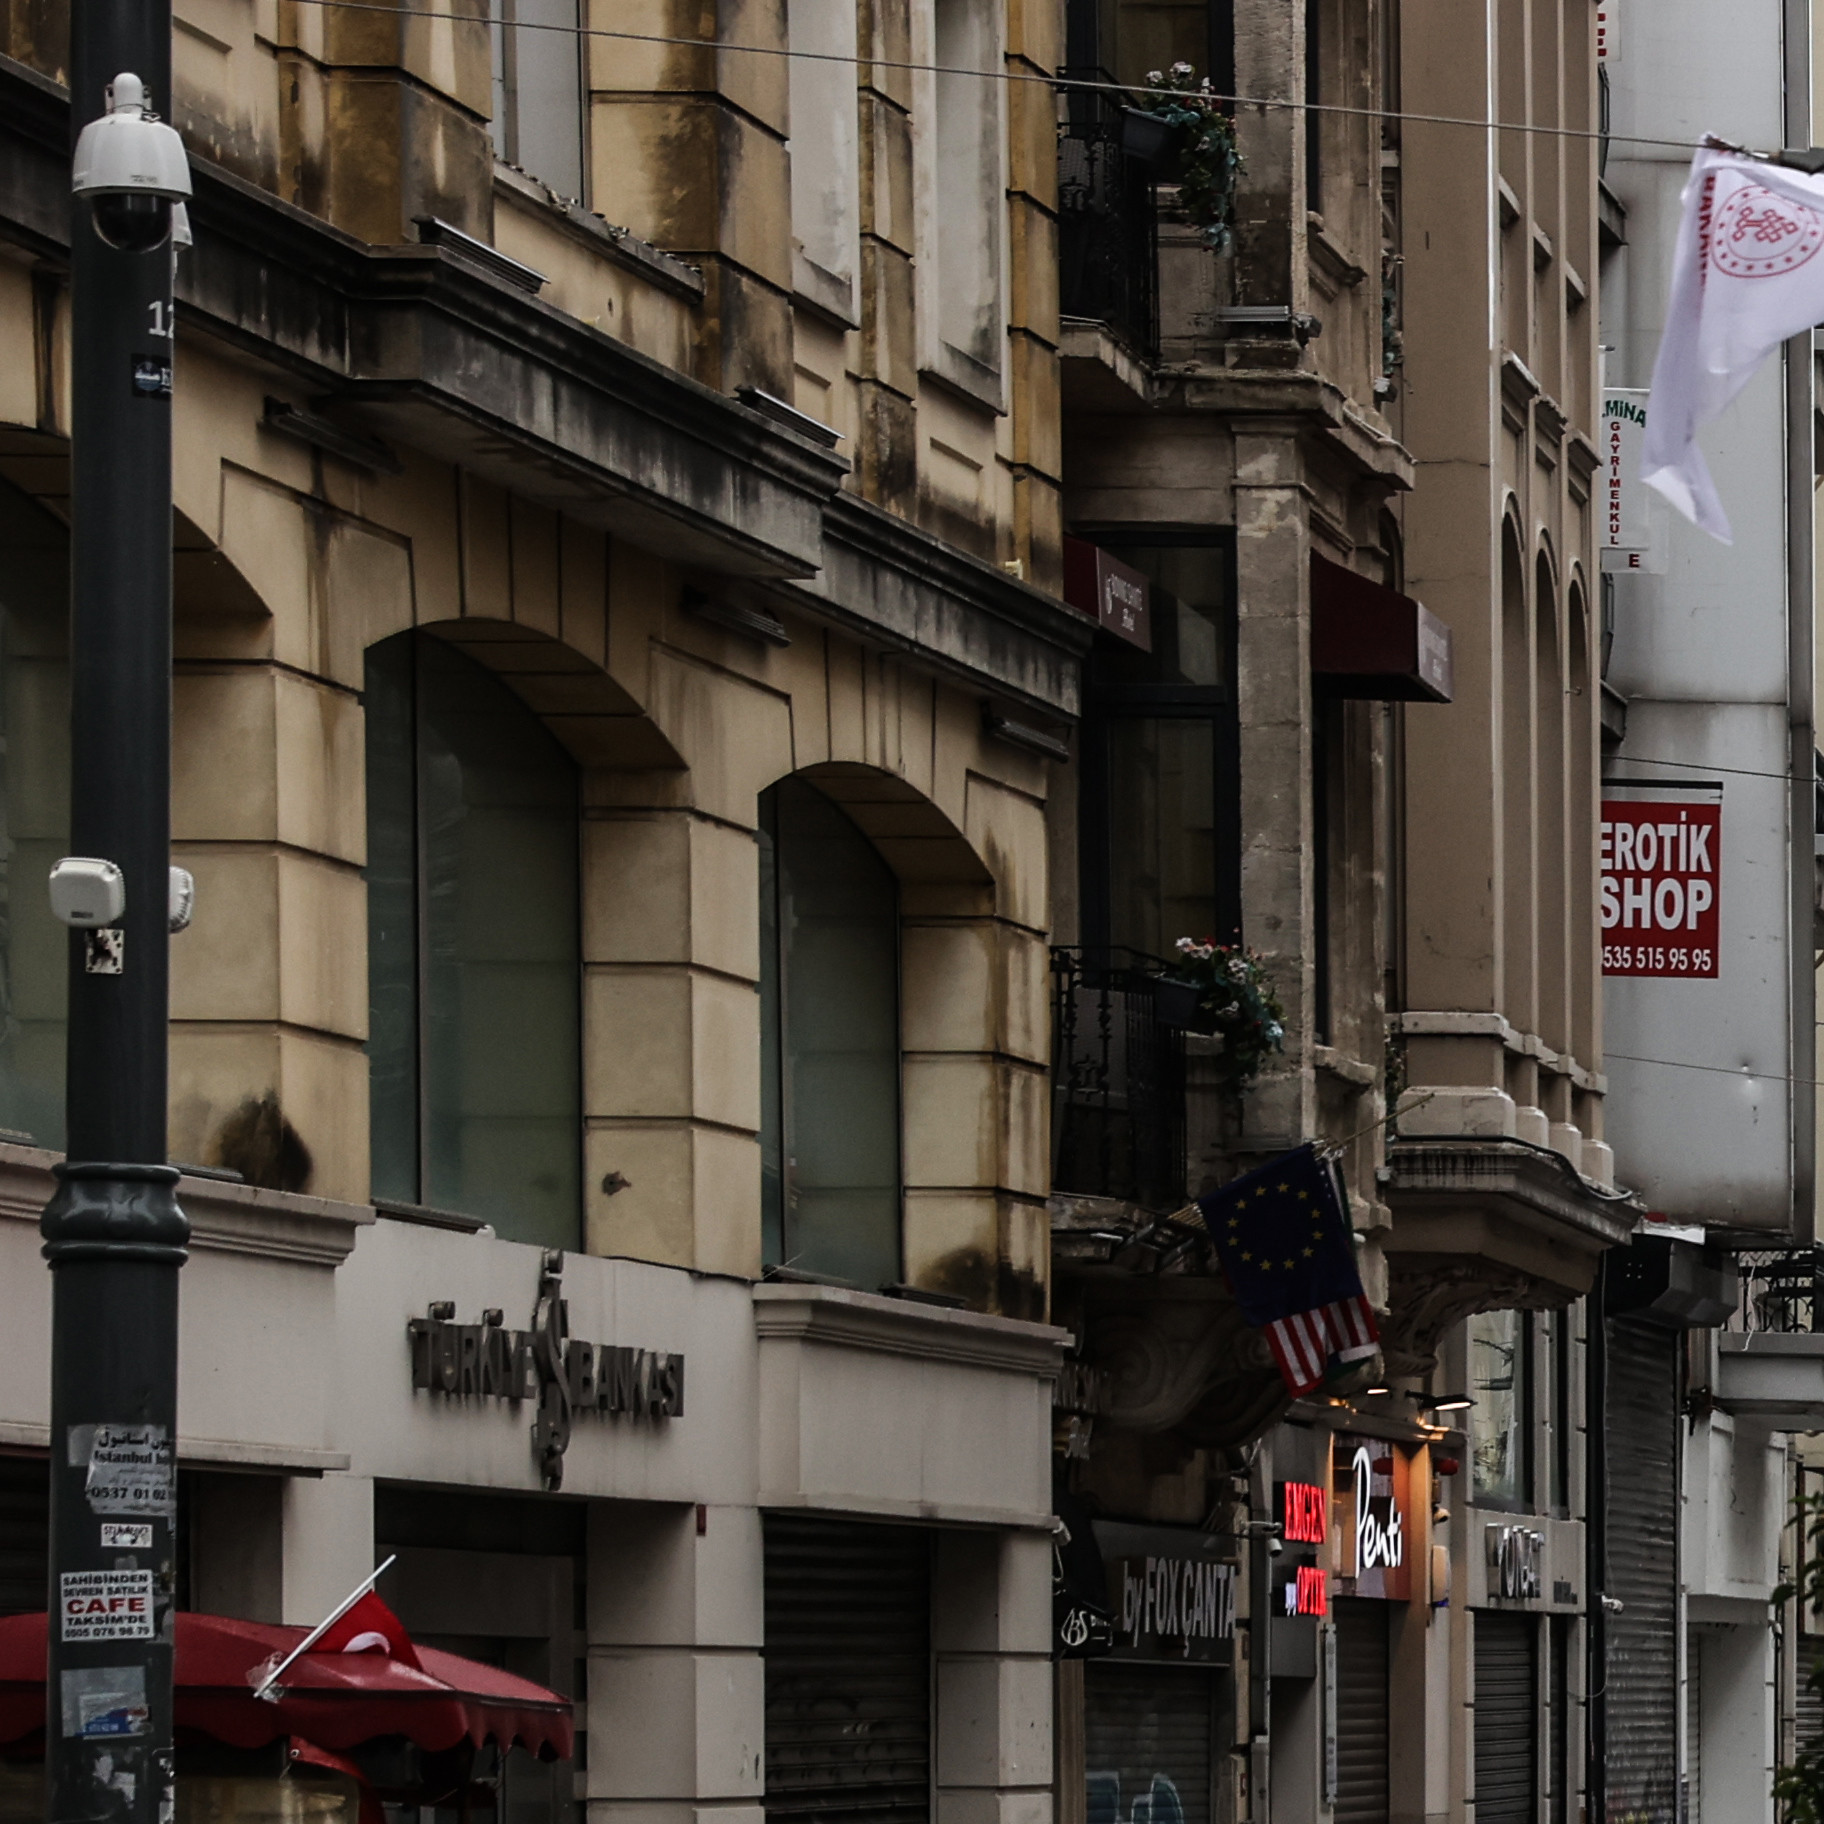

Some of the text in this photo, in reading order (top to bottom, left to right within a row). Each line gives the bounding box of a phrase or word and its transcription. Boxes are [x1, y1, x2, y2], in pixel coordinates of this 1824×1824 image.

[1603, 400, 1646, 428] MİNA
[1601, 811, 1712, 872] EROTİK
[1601, 876, 1712, 930] SHOP
[1601, 945, 1712, 972] 535 515 95 95
[408, 1300, 538, 1400] TÜRKİYE
[1352, 1446, 1403, 1579] Penti
[63, 1574, 148, 1586] SAHİBİNDEN
[66, 1597, 146, 1615] CAFE
[66, 1613, 148, 1626] TAKSİM'DE
[1122, 1561, 1144, 1648] by
[1144, 1556, 1180, 1636] FOX
[1181, 1559, 1236, 1658] ÇANTA
